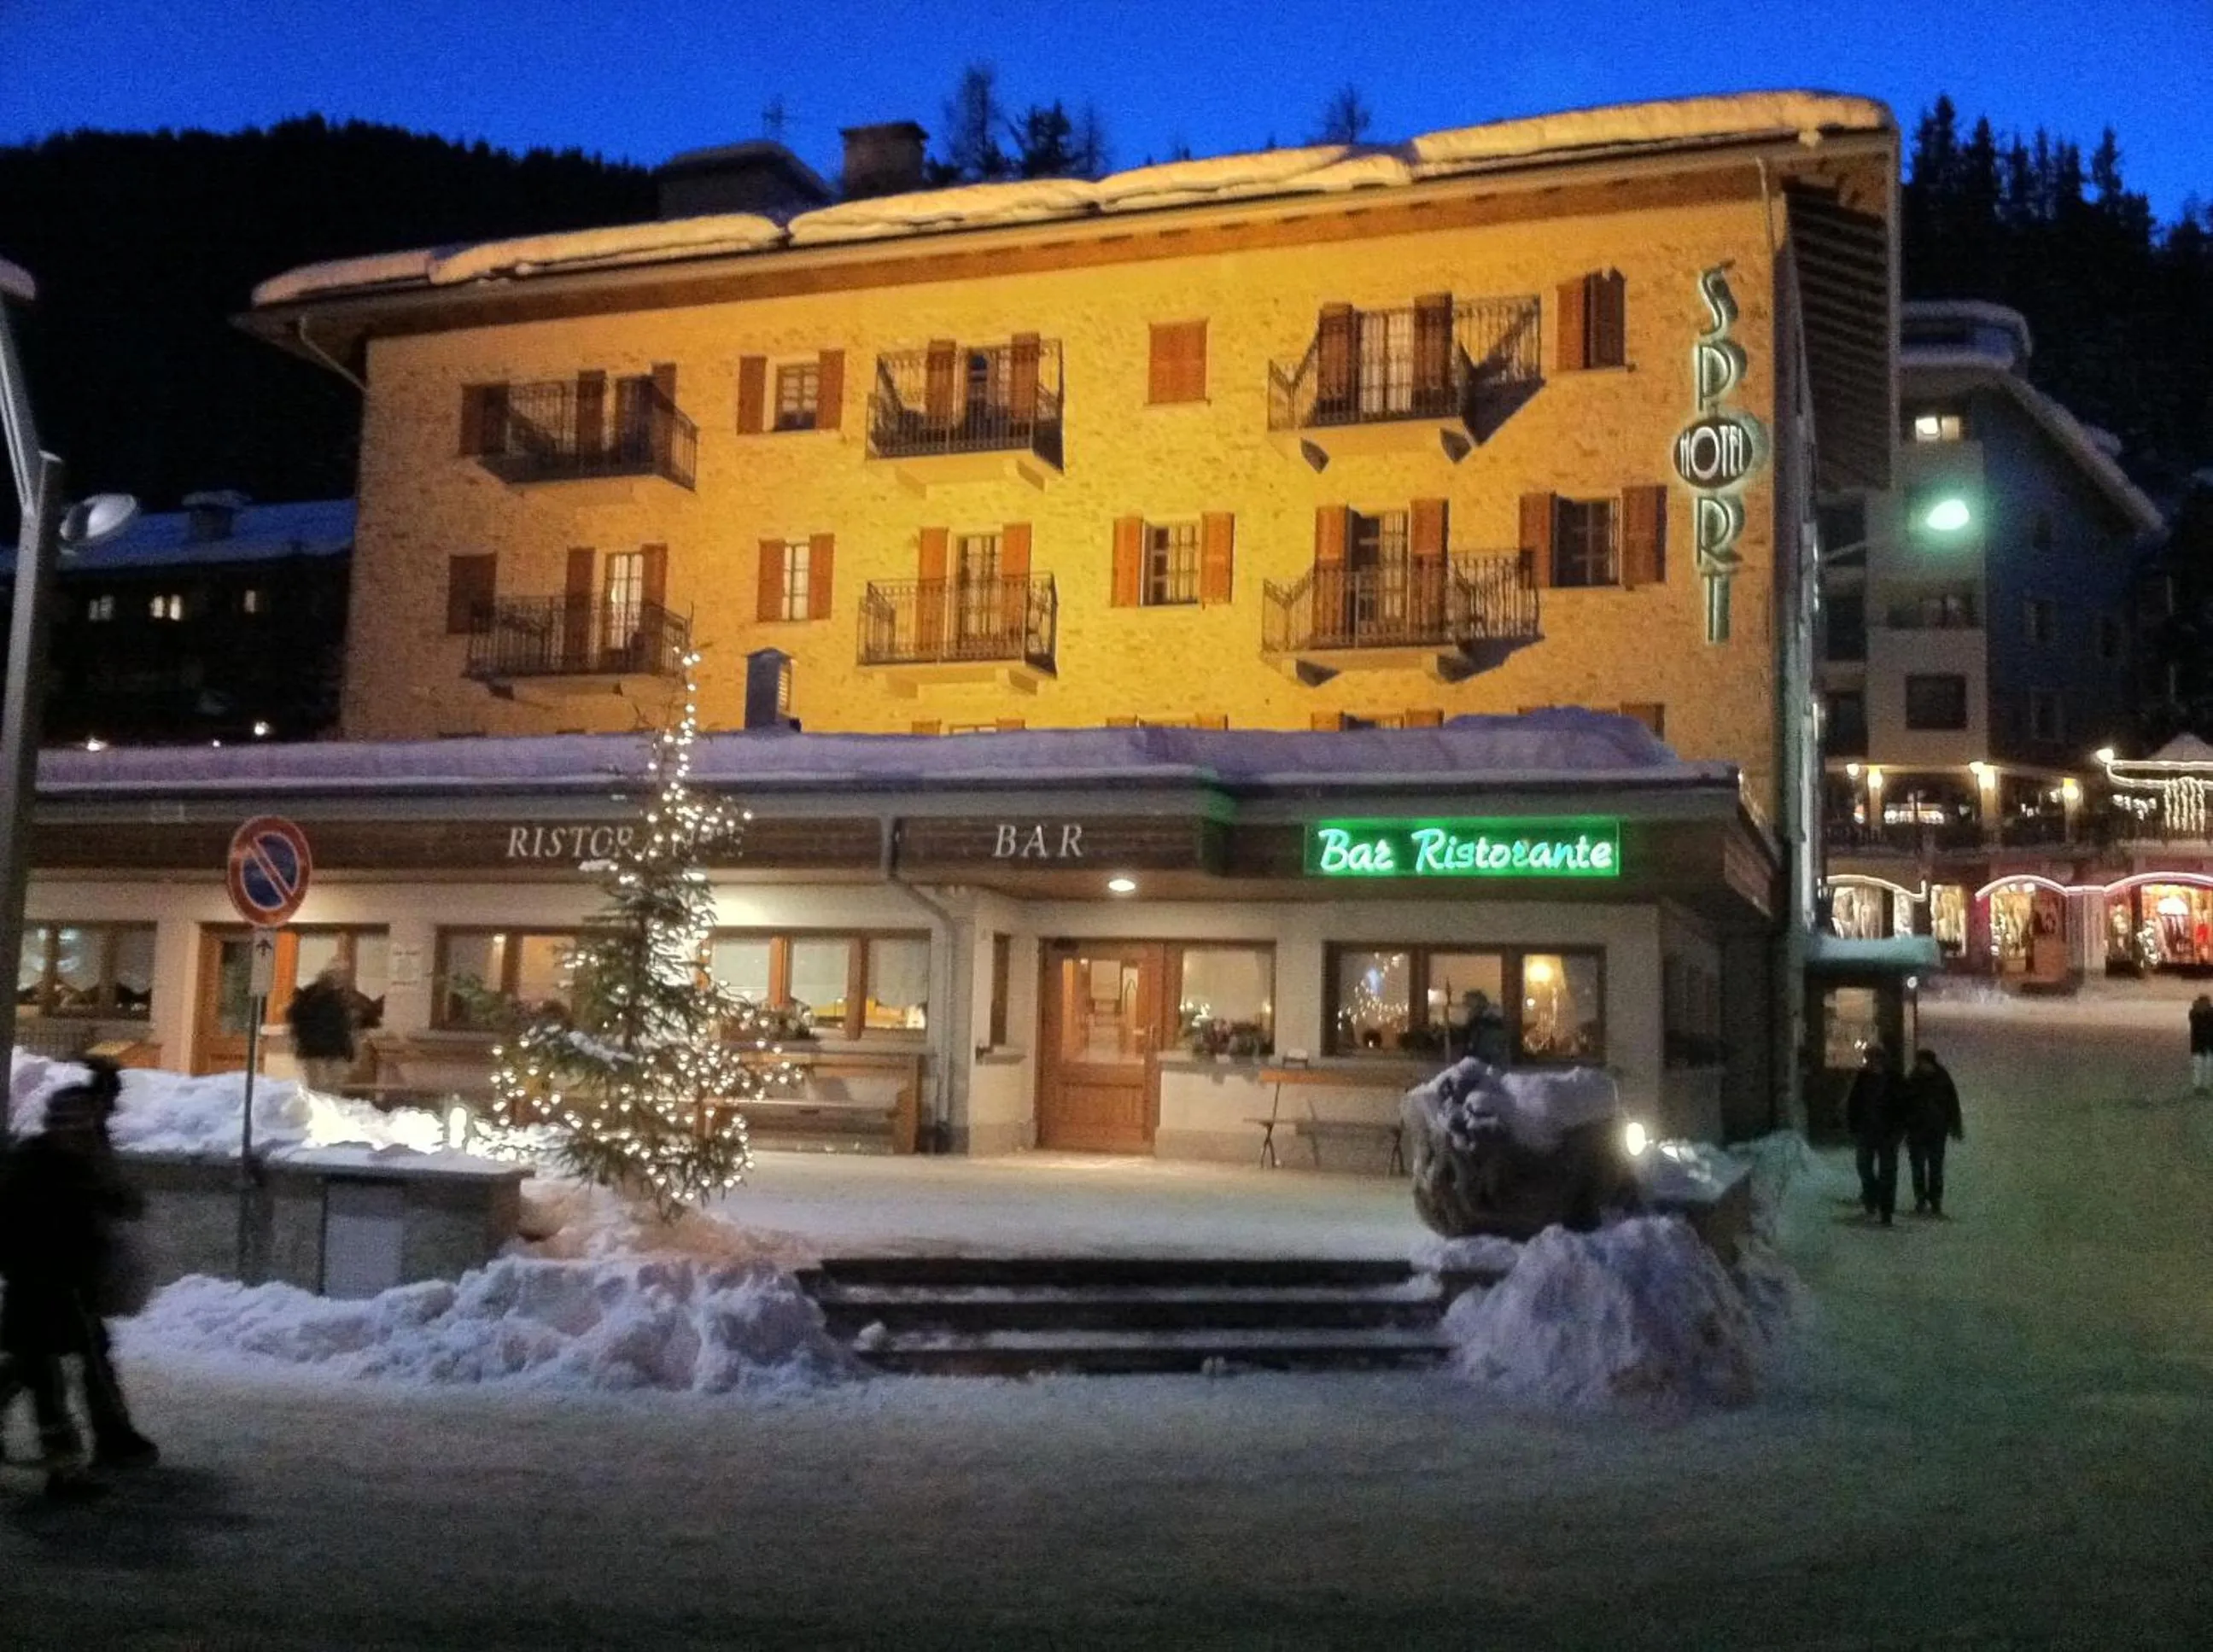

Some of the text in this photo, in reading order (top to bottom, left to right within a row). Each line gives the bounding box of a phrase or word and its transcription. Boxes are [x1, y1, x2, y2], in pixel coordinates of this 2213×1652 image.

[1679, 424, 1743, 481] HOTEL
[992, 824, 1083, 858] BAR
[1318, 828, 1614, 873] Bar Ristorante
